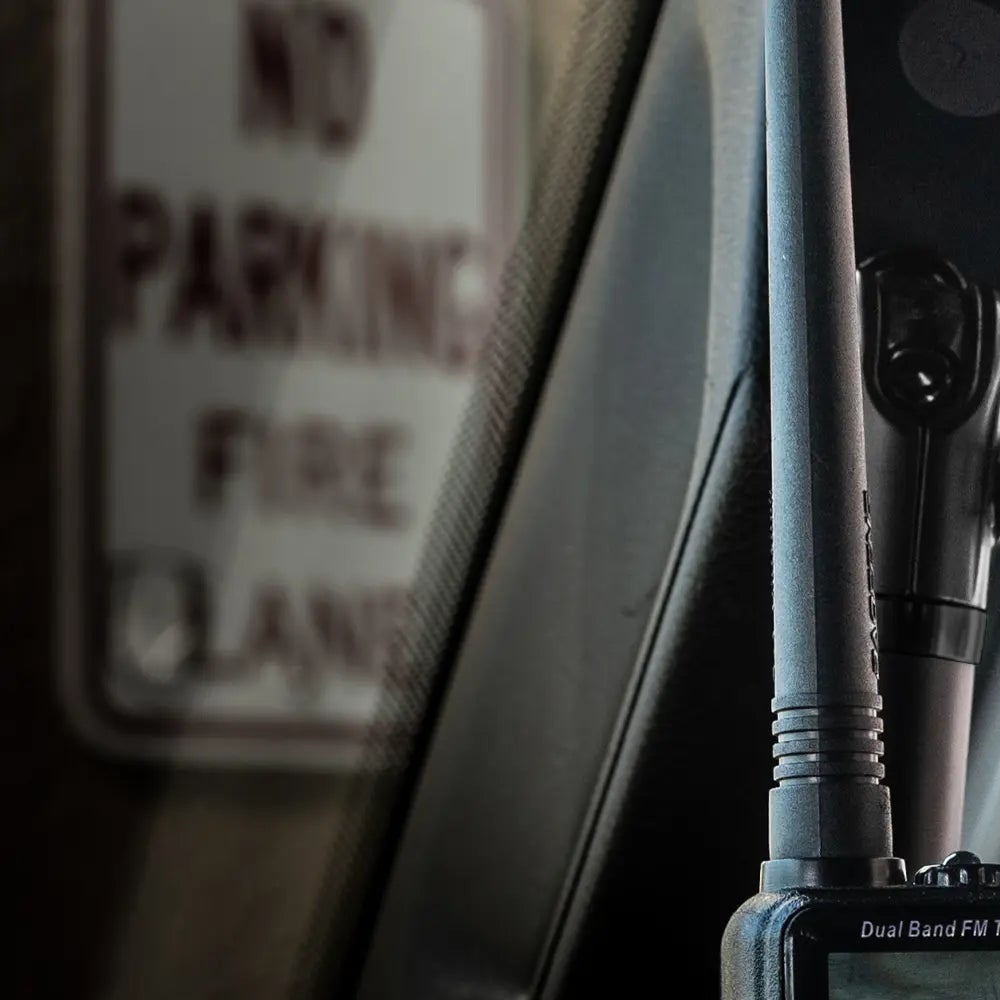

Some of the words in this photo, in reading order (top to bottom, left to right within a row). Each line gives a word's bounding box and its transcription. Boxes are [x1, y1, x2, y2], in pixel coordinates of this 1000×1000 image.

[238, 3, 374, 157] NO
[861, 920, 903, 938] Dual
[908, 920, 956, 938] Band
[960, 919, 988, 937] FM
